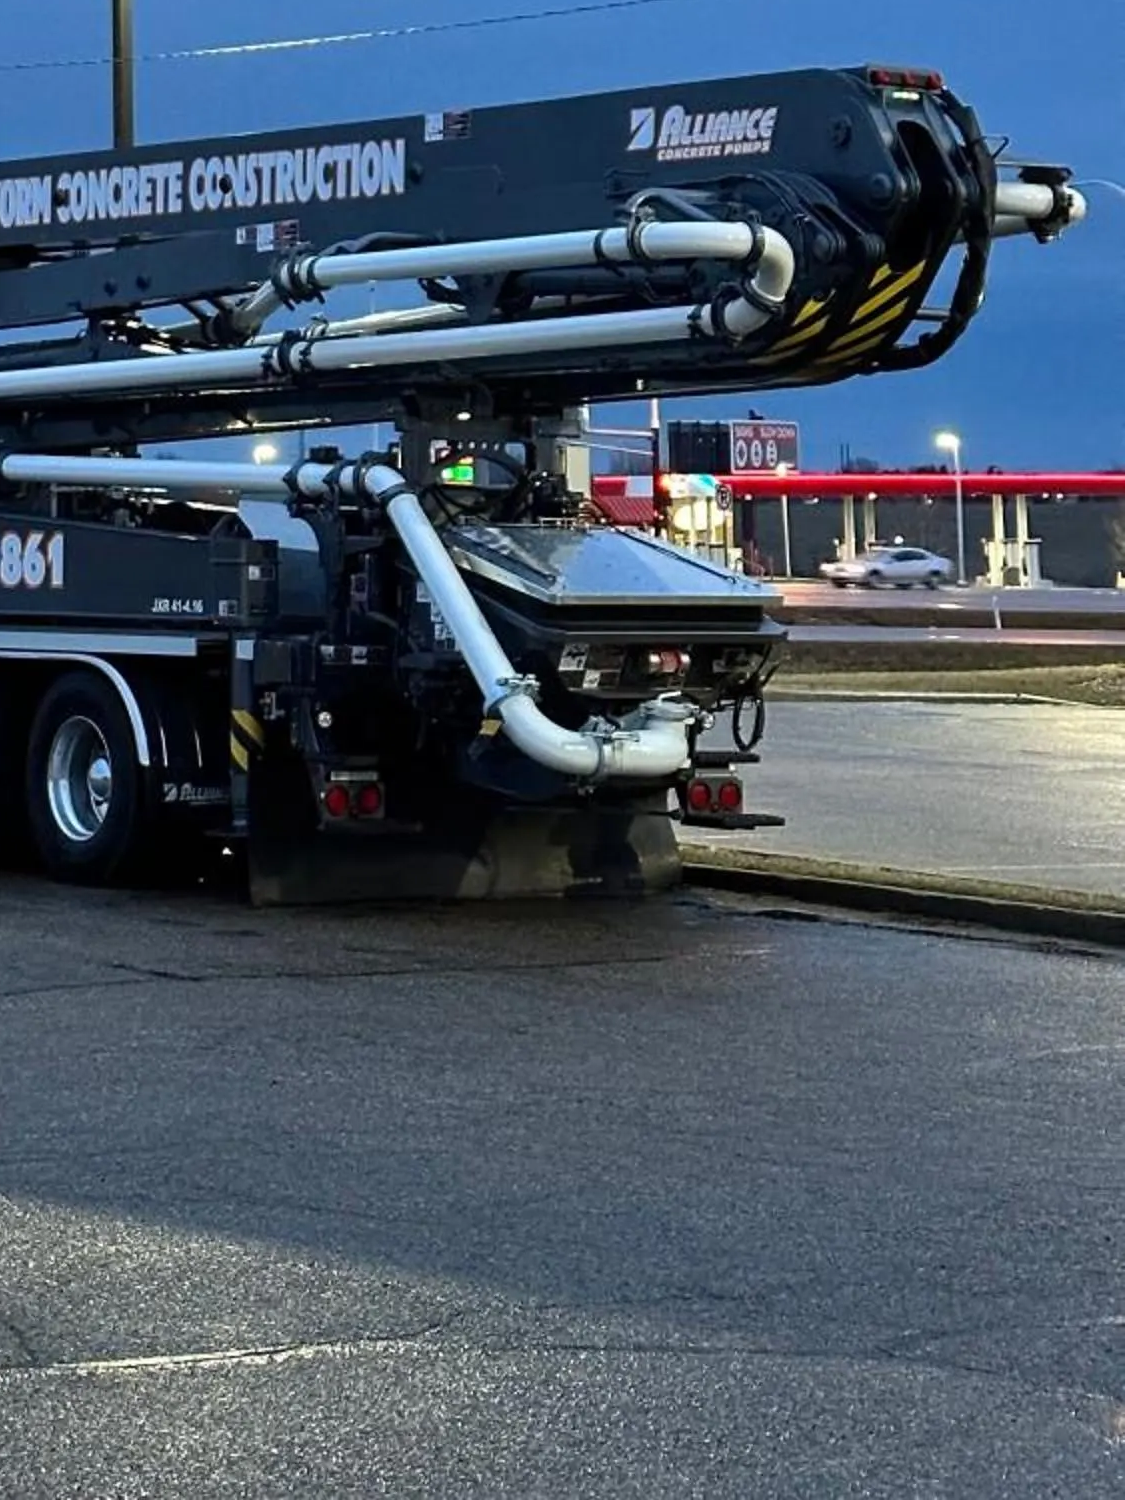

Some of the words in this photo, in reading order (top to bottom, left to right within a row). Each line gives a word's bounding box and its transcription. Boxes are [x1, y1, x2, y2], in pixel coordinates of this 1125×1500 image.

[657, 145, 722, 161] CONCRETE
[56, 161, 184, 224] CONCRETE
[189, 139, 406, 212] CONSTRUCTION
